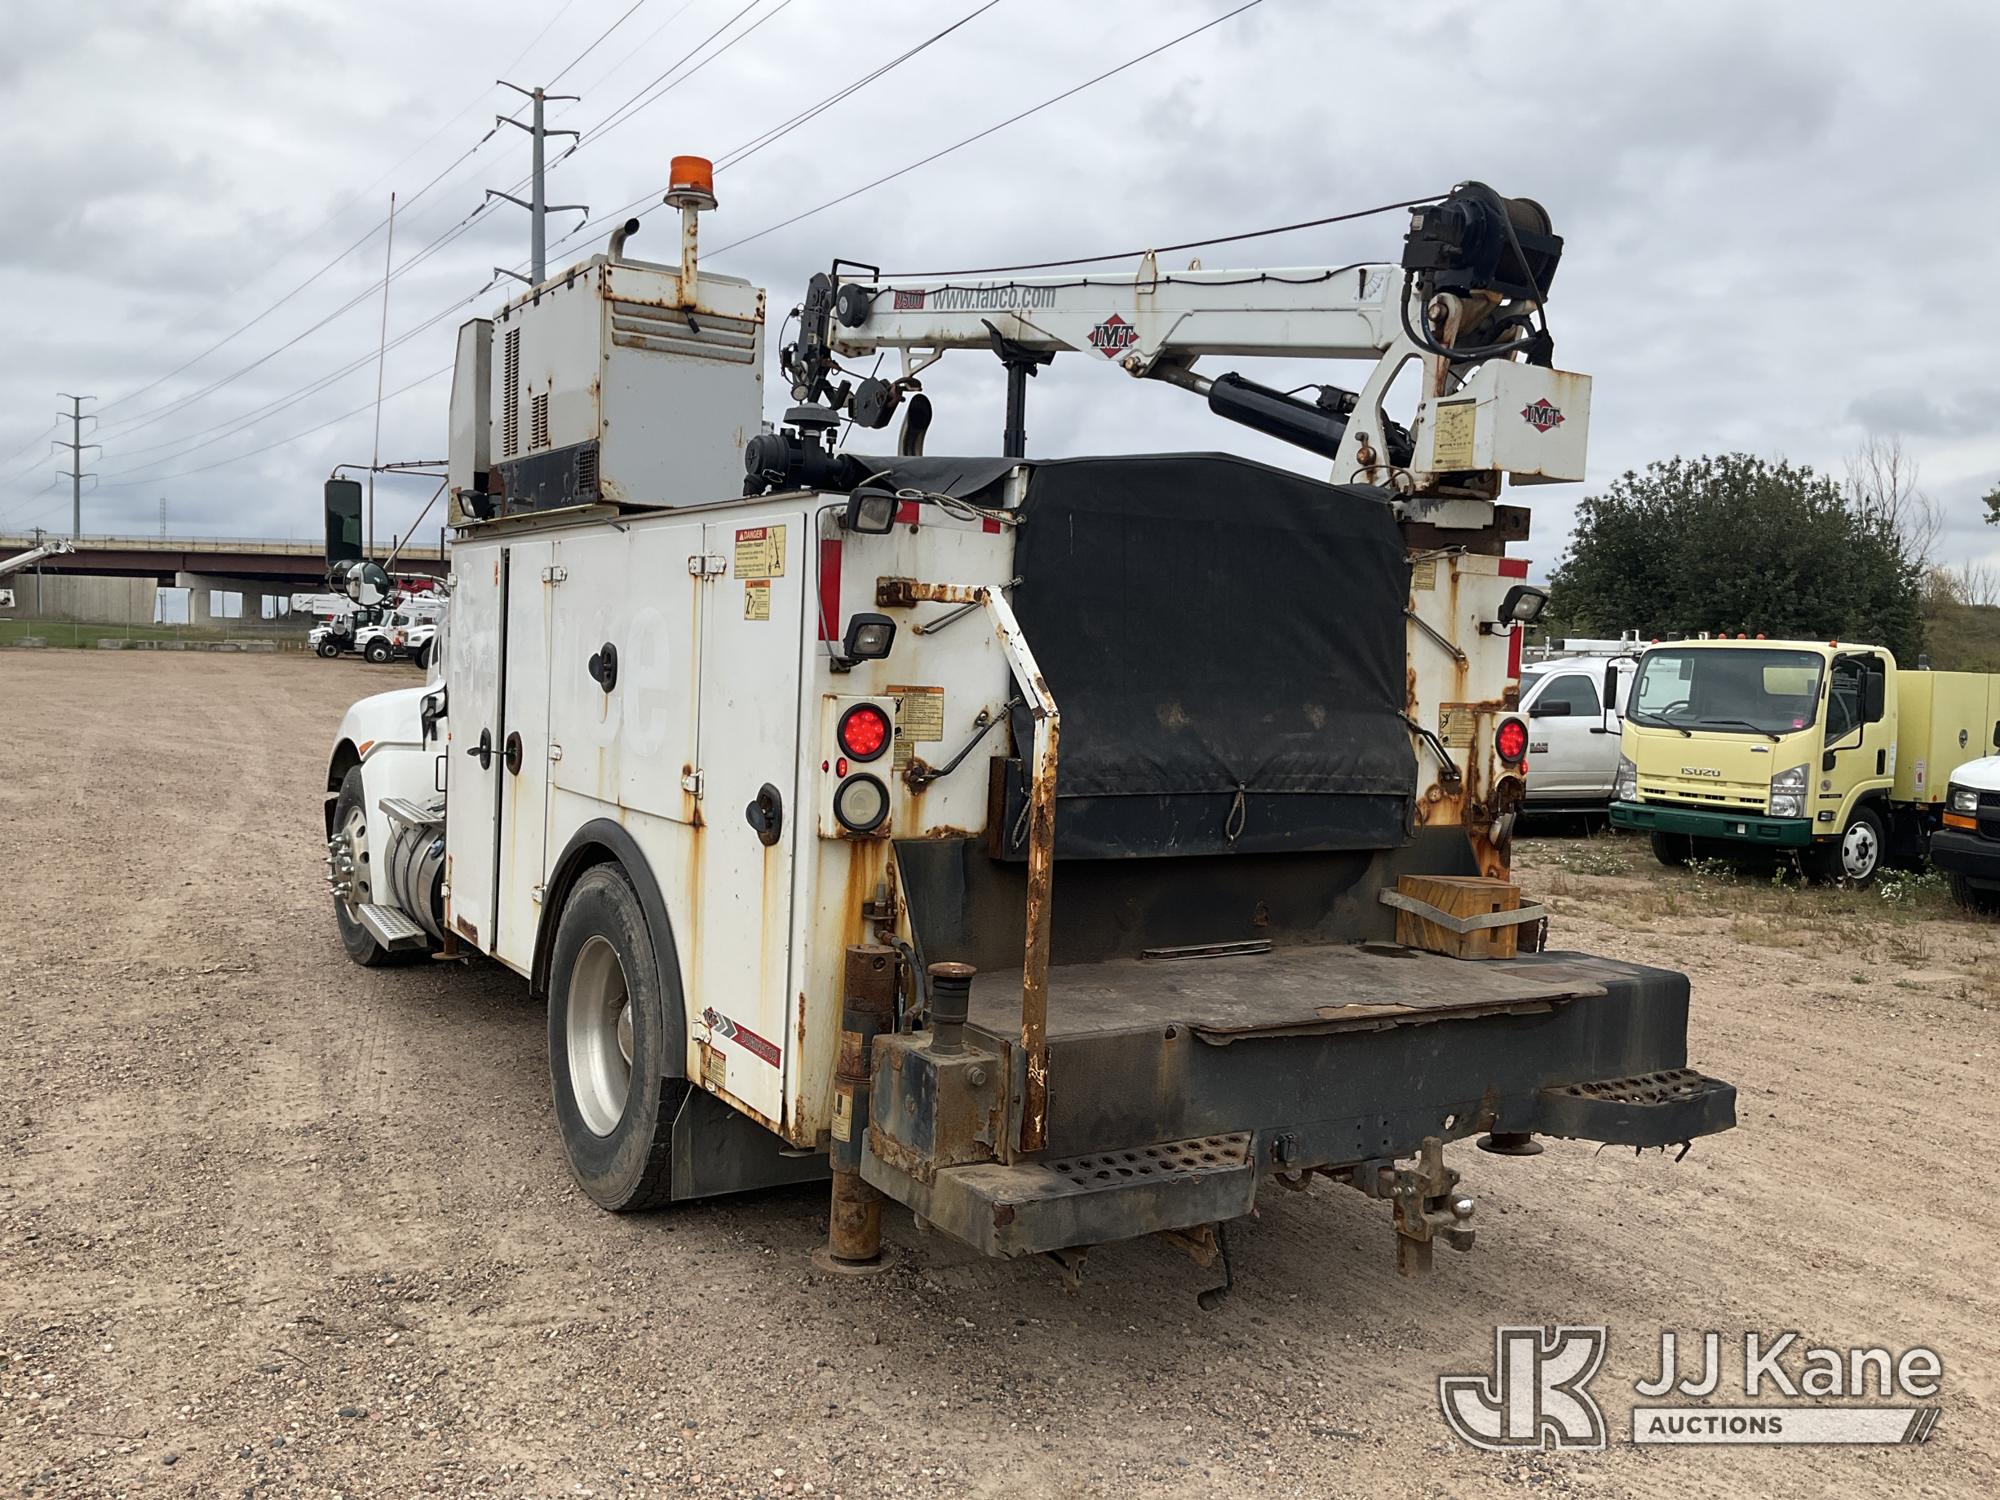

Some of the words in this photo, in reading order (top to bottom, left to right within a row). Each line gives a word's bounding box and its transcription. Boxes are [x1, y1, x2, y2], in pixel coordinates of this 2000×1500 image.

[933, 282, 1057, 309] www.fabco.com
[1092, 325, 1134, 348] IMT
[1526, 405, 1560, 426] IMT
[743, 529, 763, 540] DANGER
[1681, 767, 1720, 777] ISUZU
